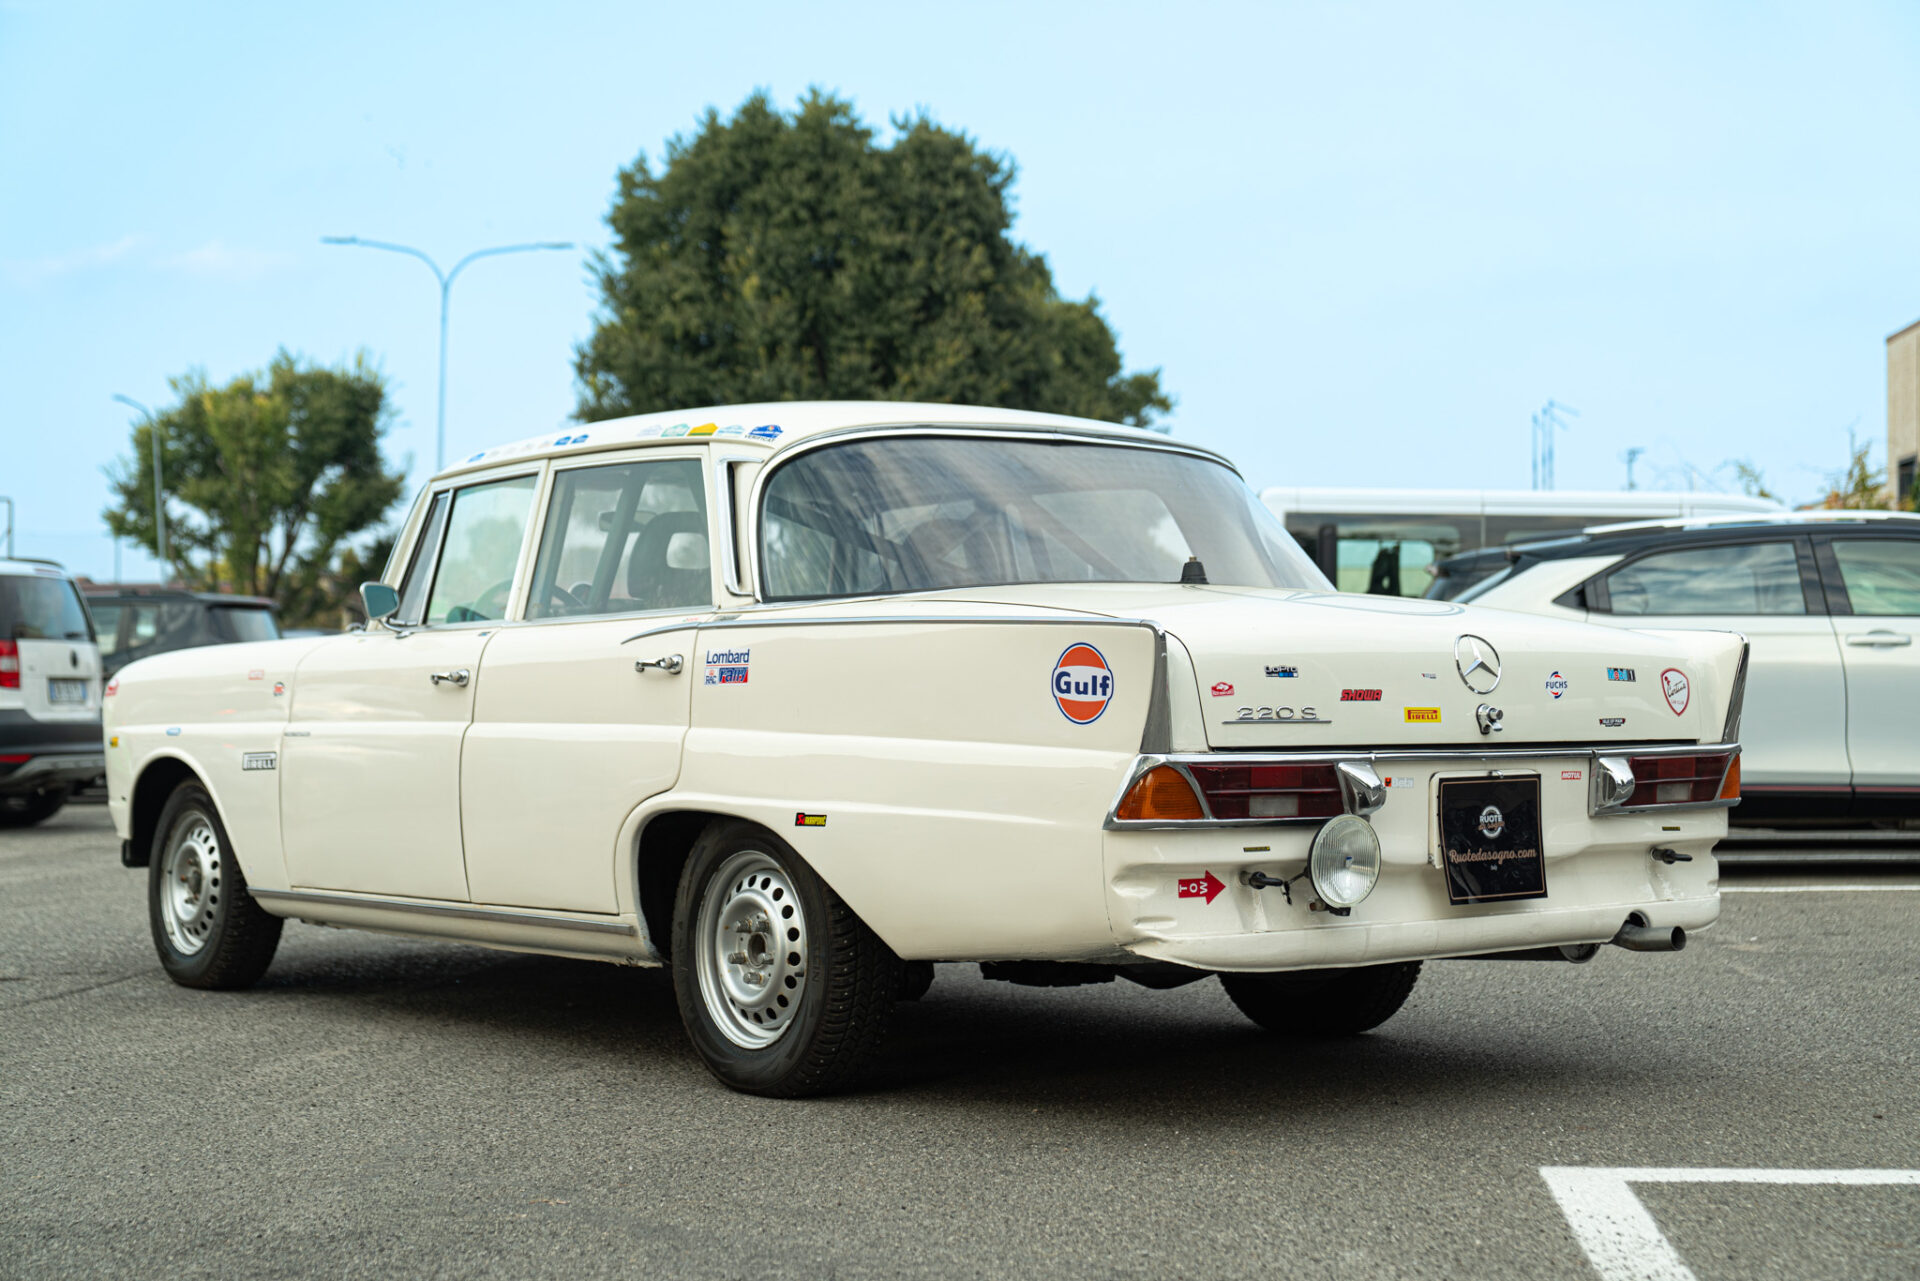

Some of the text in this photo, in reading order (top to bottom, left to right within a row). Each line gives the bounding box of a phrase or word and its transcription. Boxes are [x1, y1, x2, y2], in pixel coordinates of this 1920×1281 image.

[706, 649, 750, 664] Lombard
[705, 668, 748, 684] RAC rally
[1055, 671, 1110, 696] Gulf
[1545, 681, 1568, 689] FUCHS
[1340, 689, 1382, 701] SHOWA
[1237, 706, 1294, 720] 220
[1407, 709, 1438, 720] PIRELLI
[243, 753, 277, 769] PIRELLI
[1480, 815, 1503, 823] RUOTE
[1449, 848, 1537, 865] Ruotedasogno.com
[1179, 881, 1208, 894] TOW
